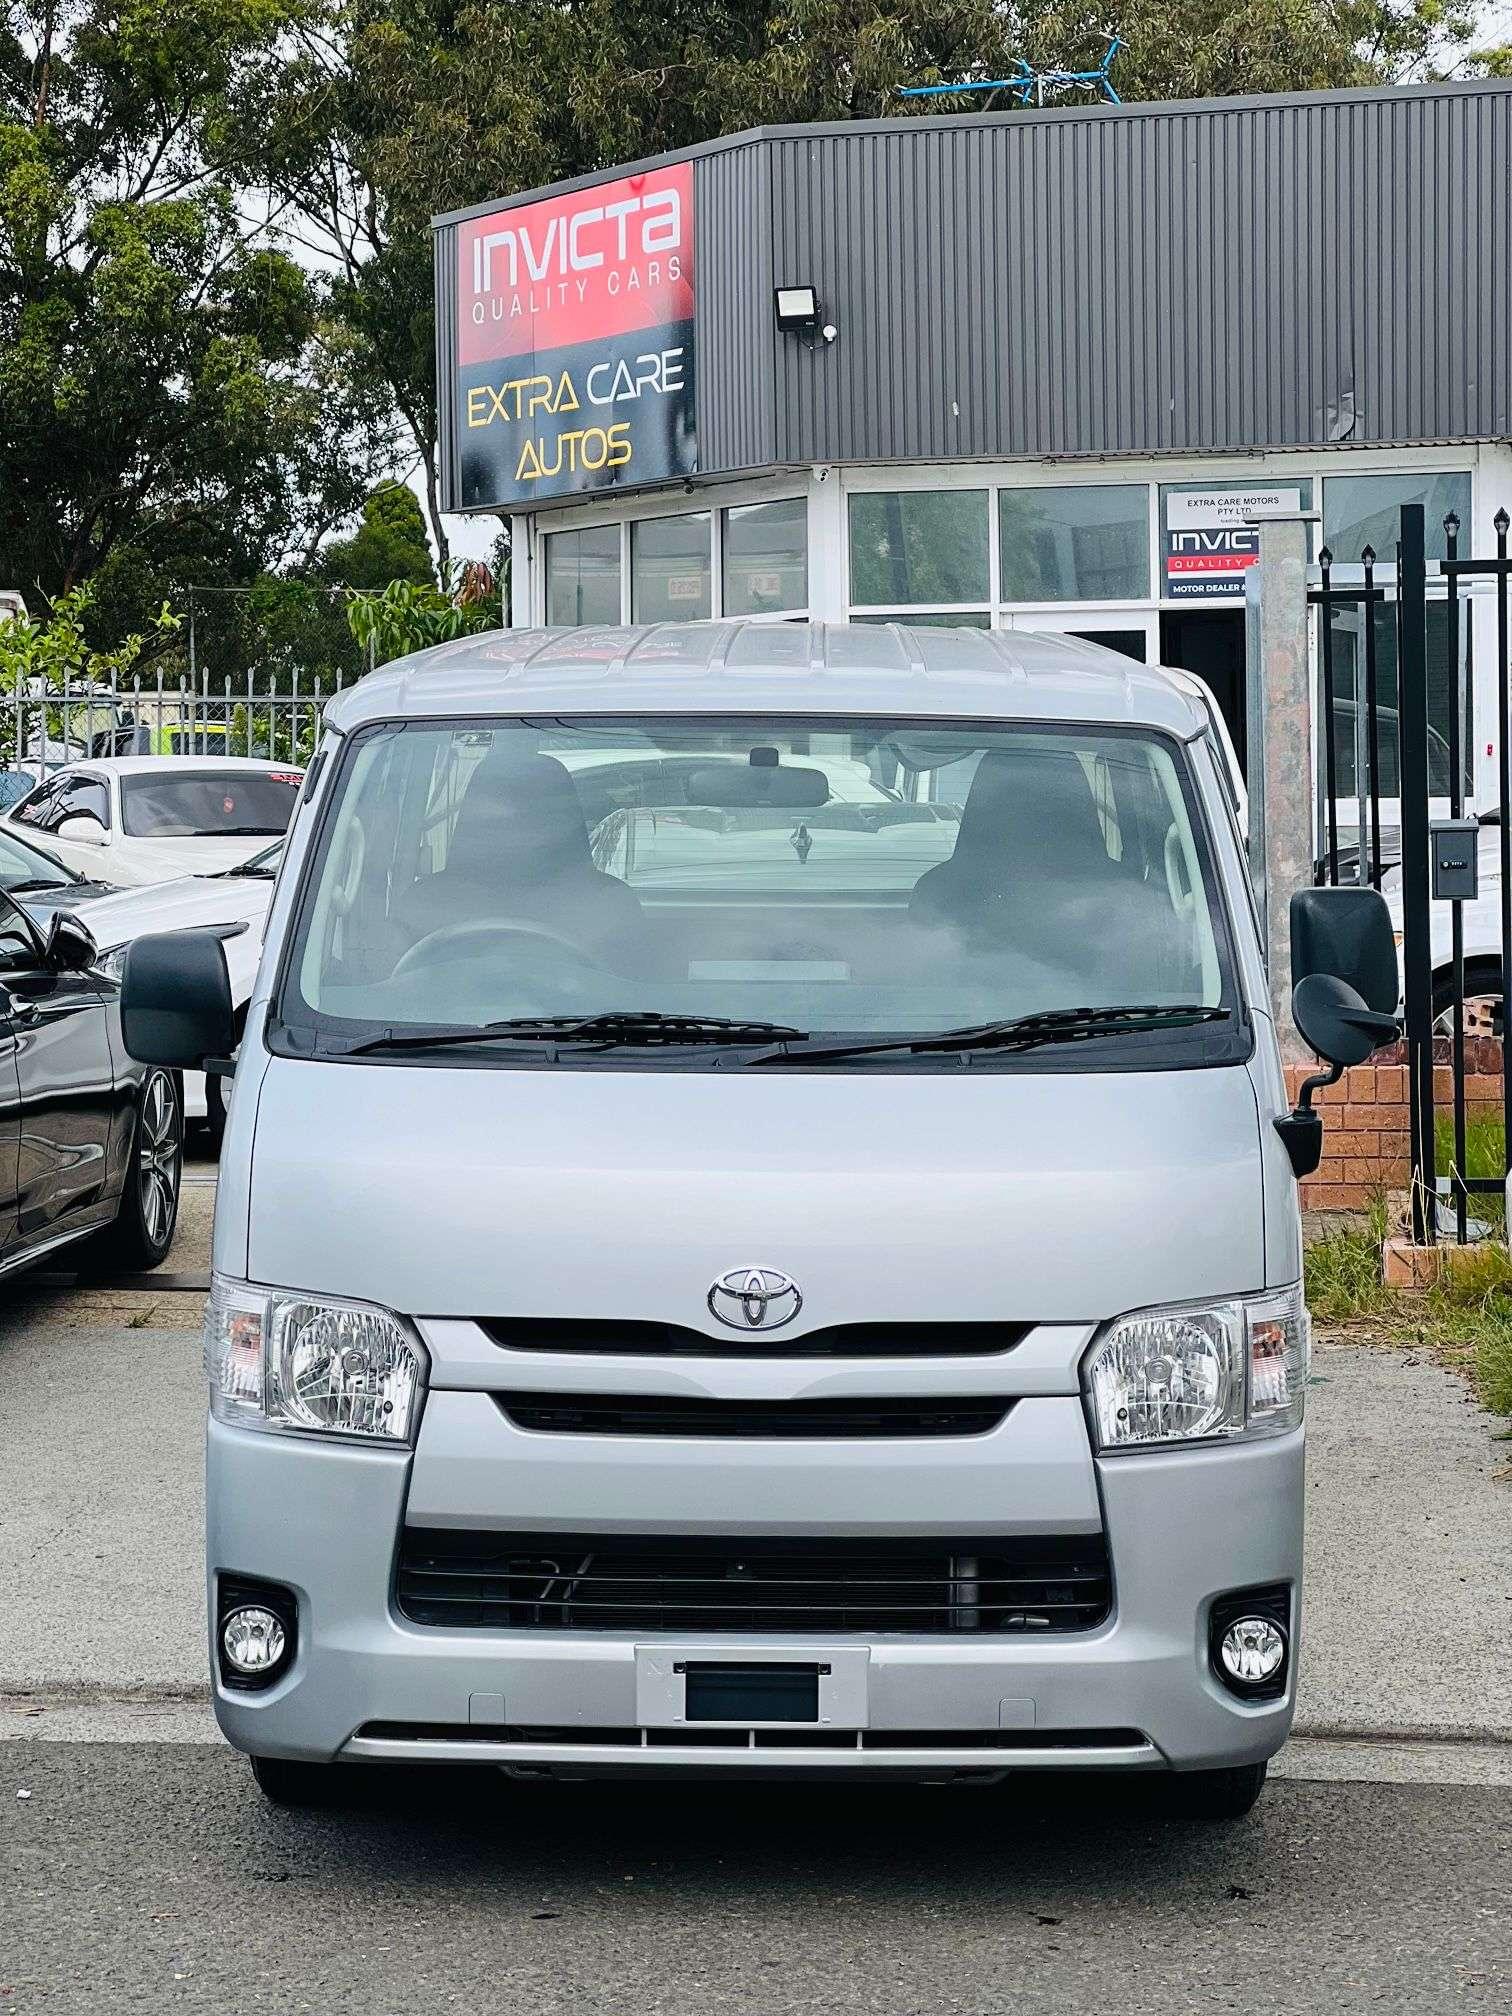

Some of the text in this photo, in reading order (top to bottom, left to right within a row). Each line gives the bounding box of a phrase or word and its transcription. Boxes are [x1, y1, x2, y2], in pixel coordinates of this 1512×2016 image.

[472, 255, 682, 324] QUALITY CARS
[467, 347, 685, 427] EXTRA CARE
[515, 422, 632, 481] AUTOS
[1187, 496, 1280, 507] EXTRA CARE MOTORS
[1174, 559, 1242, 569] QUALITY
[1173, 585, 1205, 593] MOTOR
[1206, 583, 1240, 592] DEALER
